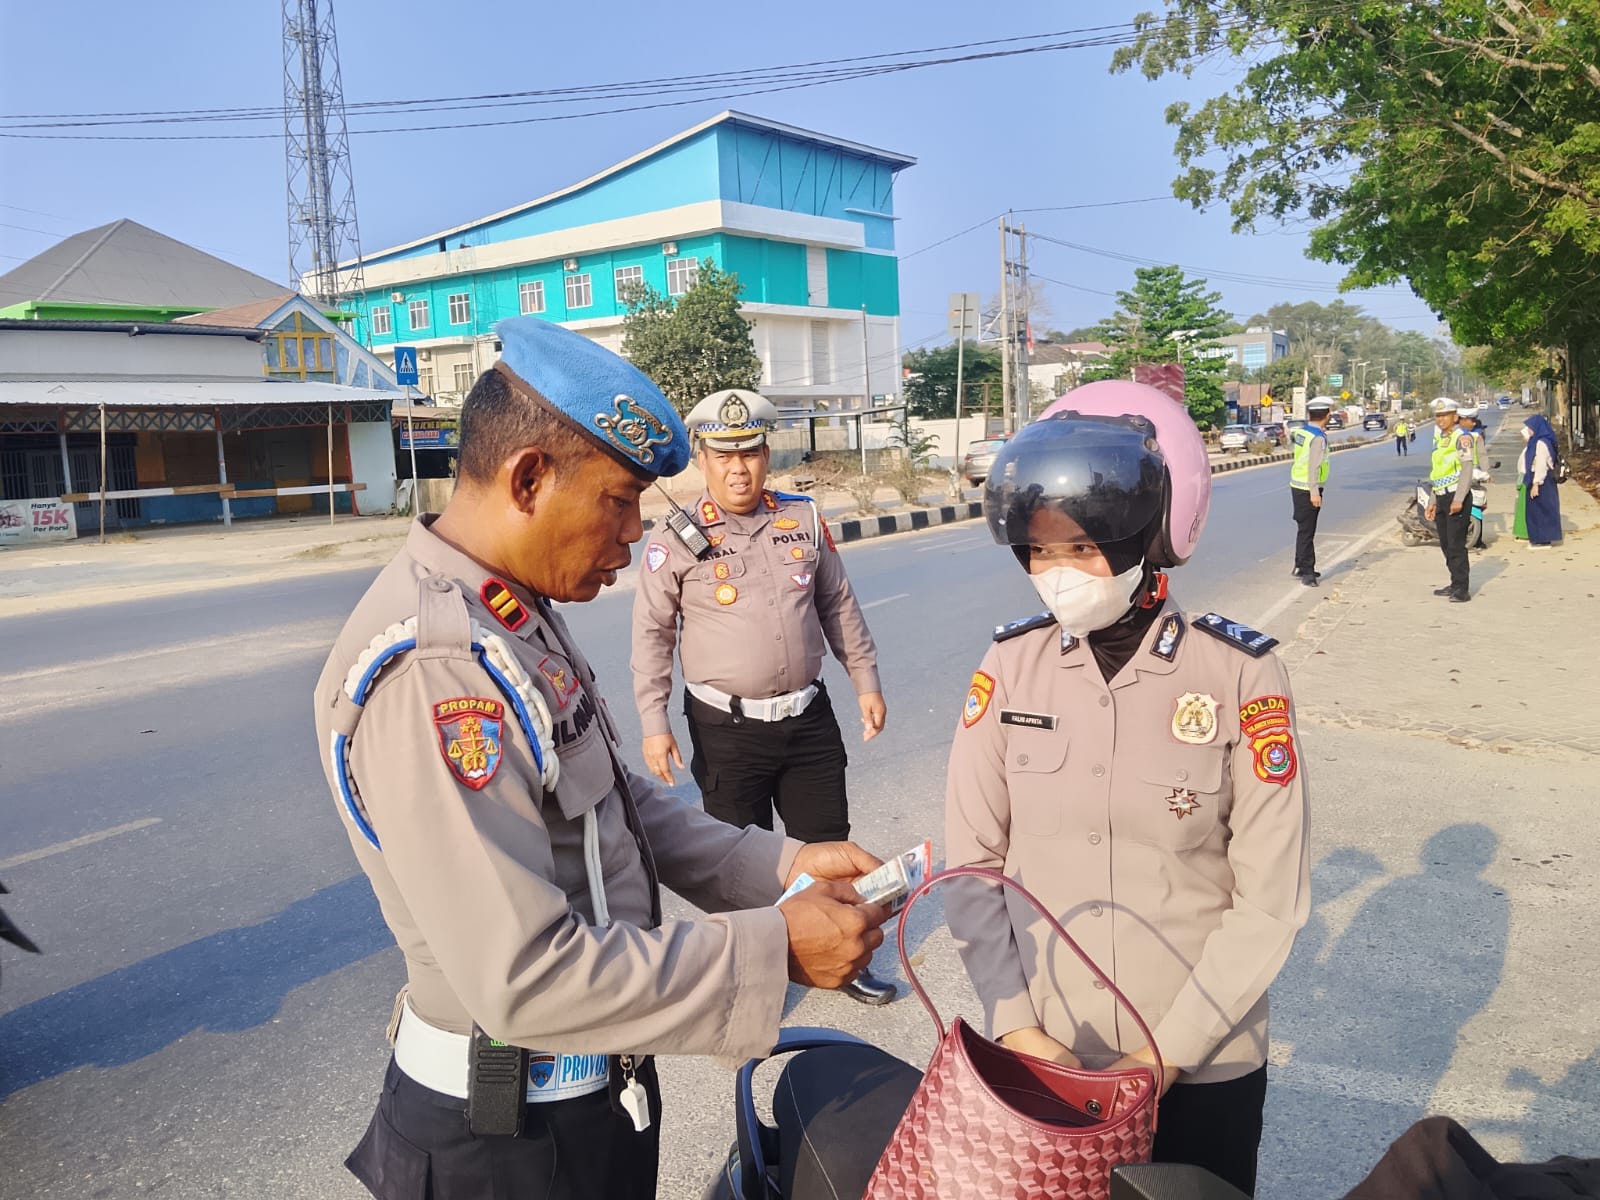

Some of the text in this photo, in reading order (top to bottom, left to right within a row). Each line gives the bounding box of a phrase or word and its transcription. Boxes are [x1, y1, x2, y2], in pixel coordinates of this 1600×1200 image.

[32, 509, 69, 526] 15K
[772, 532, 810, 545] POLRI
[440, 700, 496, 713] PROPAM
[1240, 698, 1285, 722] POLDA
